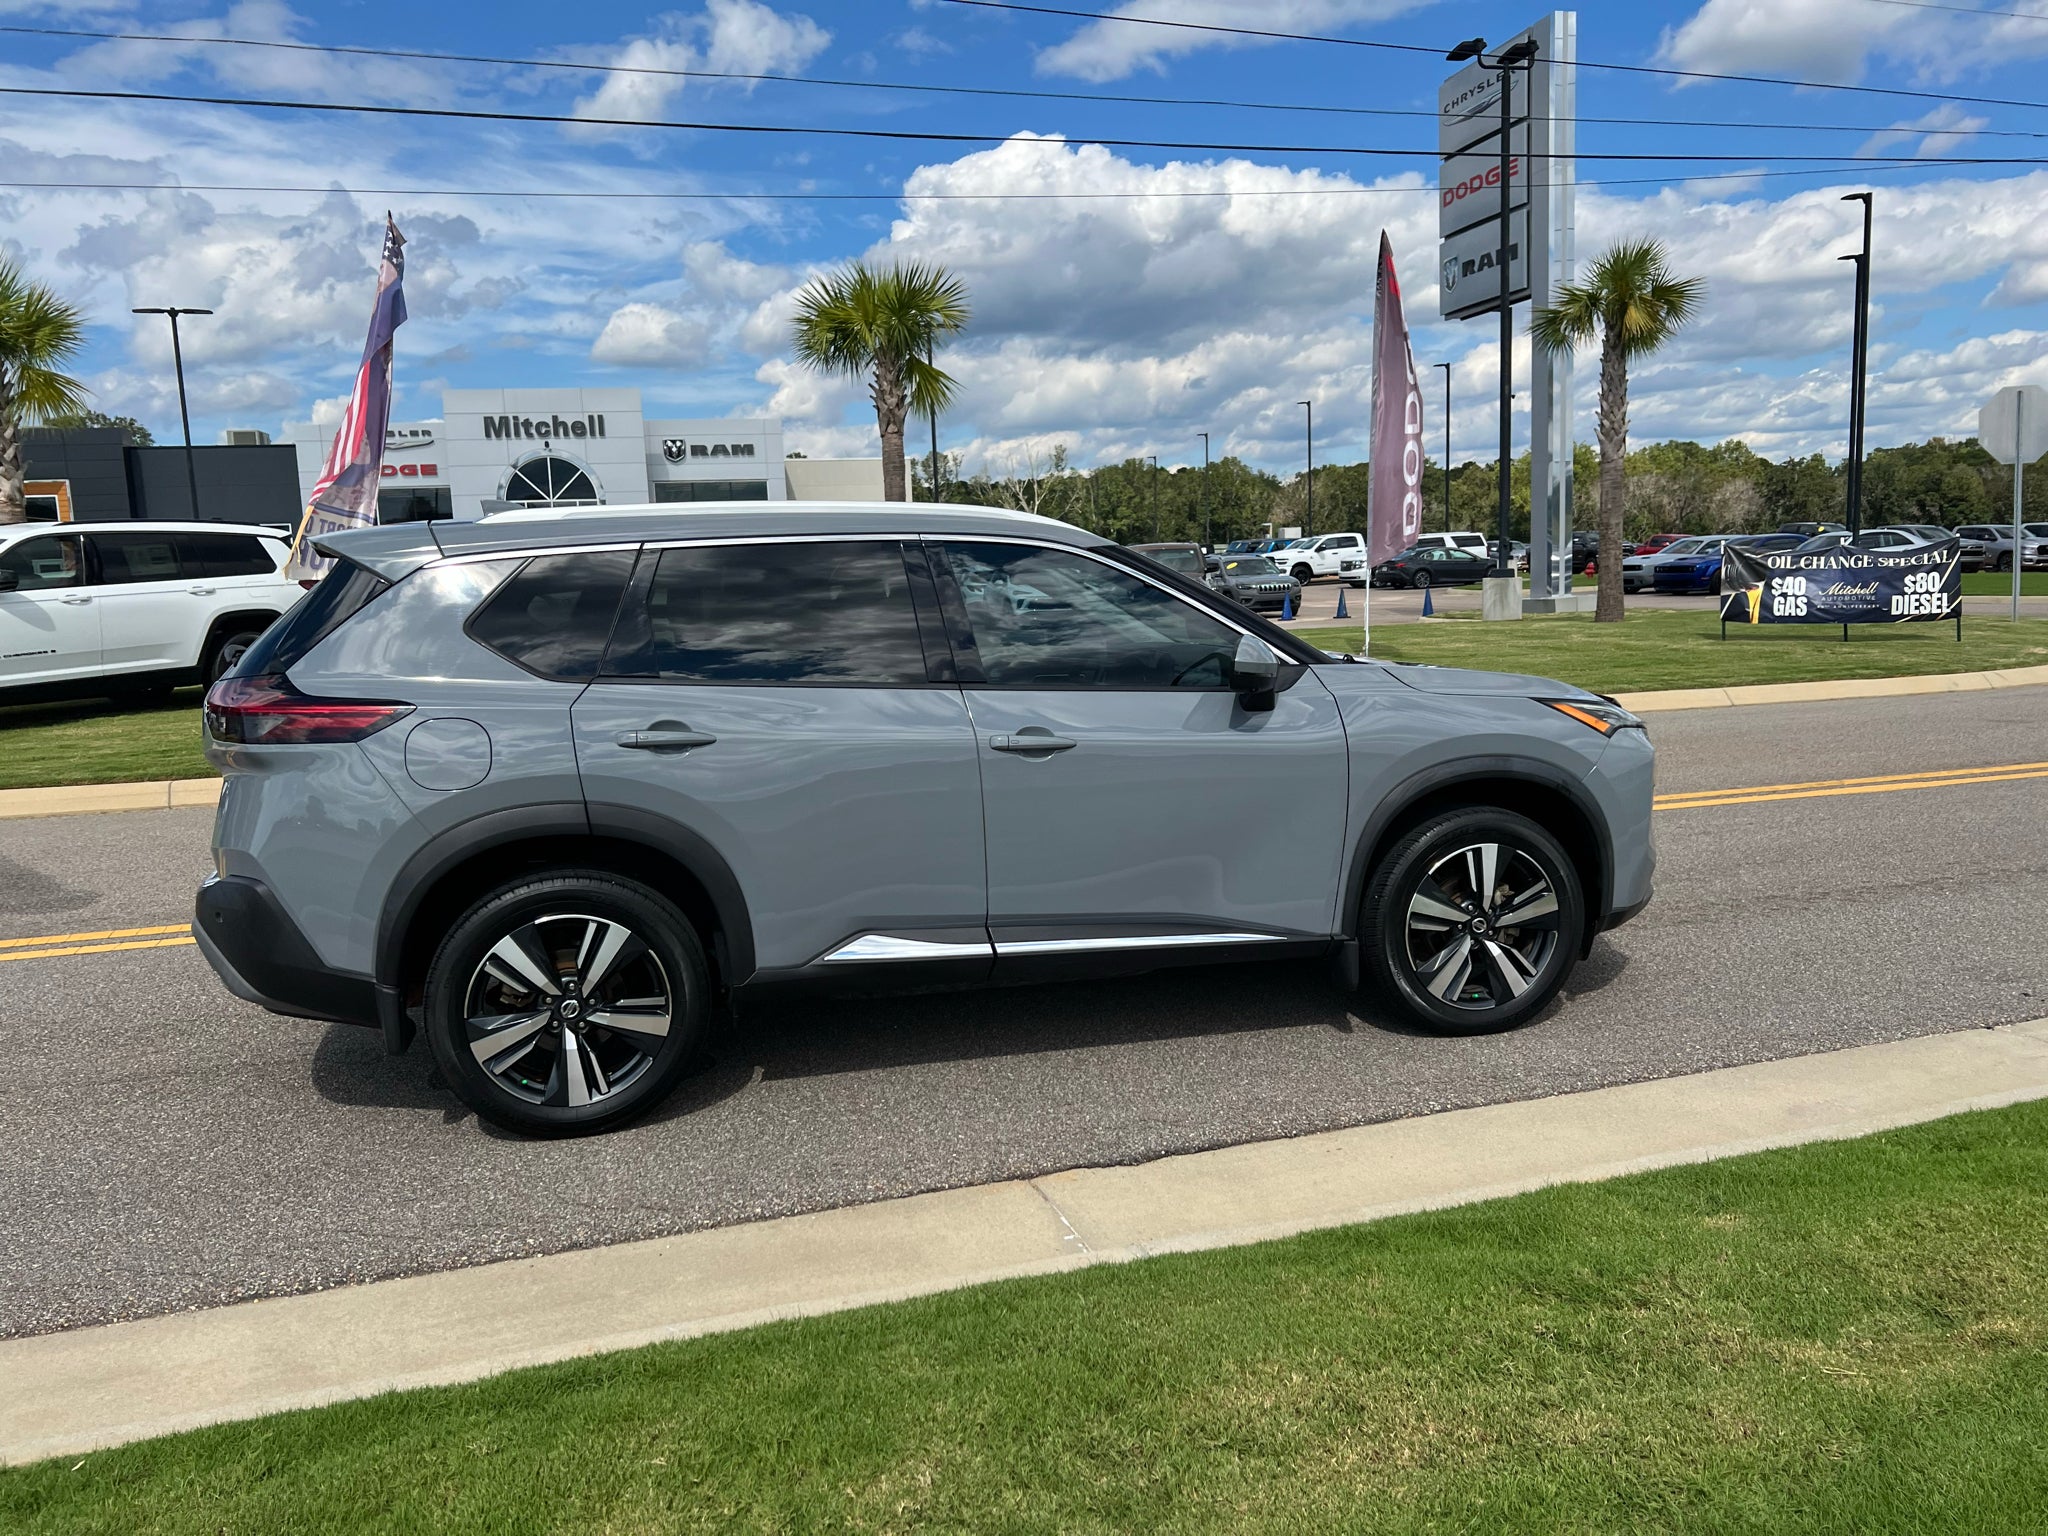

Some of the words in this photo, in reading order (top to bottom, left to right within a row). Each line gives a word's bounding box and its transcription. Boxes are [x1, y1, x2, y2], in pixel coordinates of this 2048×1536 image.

[1443, 69, 1516, 114] CHRYSLE
[1443, 158, 1519, 208] DODGE
[386, 429, 432, 438] SLER
[483, 414, 606, 439] Mitchell
[690, 443, 755, 458] RAM
[381, 463, 438, 477] DGE
[1767, 555, 1798, 570] OIL
[1800, 554, 1874, 570] CHANGE
[1877, 550, 1953, 568] SPECIAL
[1771, 575, 1807, 598] $40
[1819, 582, 1879, 595] Mitchell
[1903, 571, 1941, 595] $80
[1773, 596, 1808, 617] GAS
[1890, 592, 1952, 616] DIESEL
